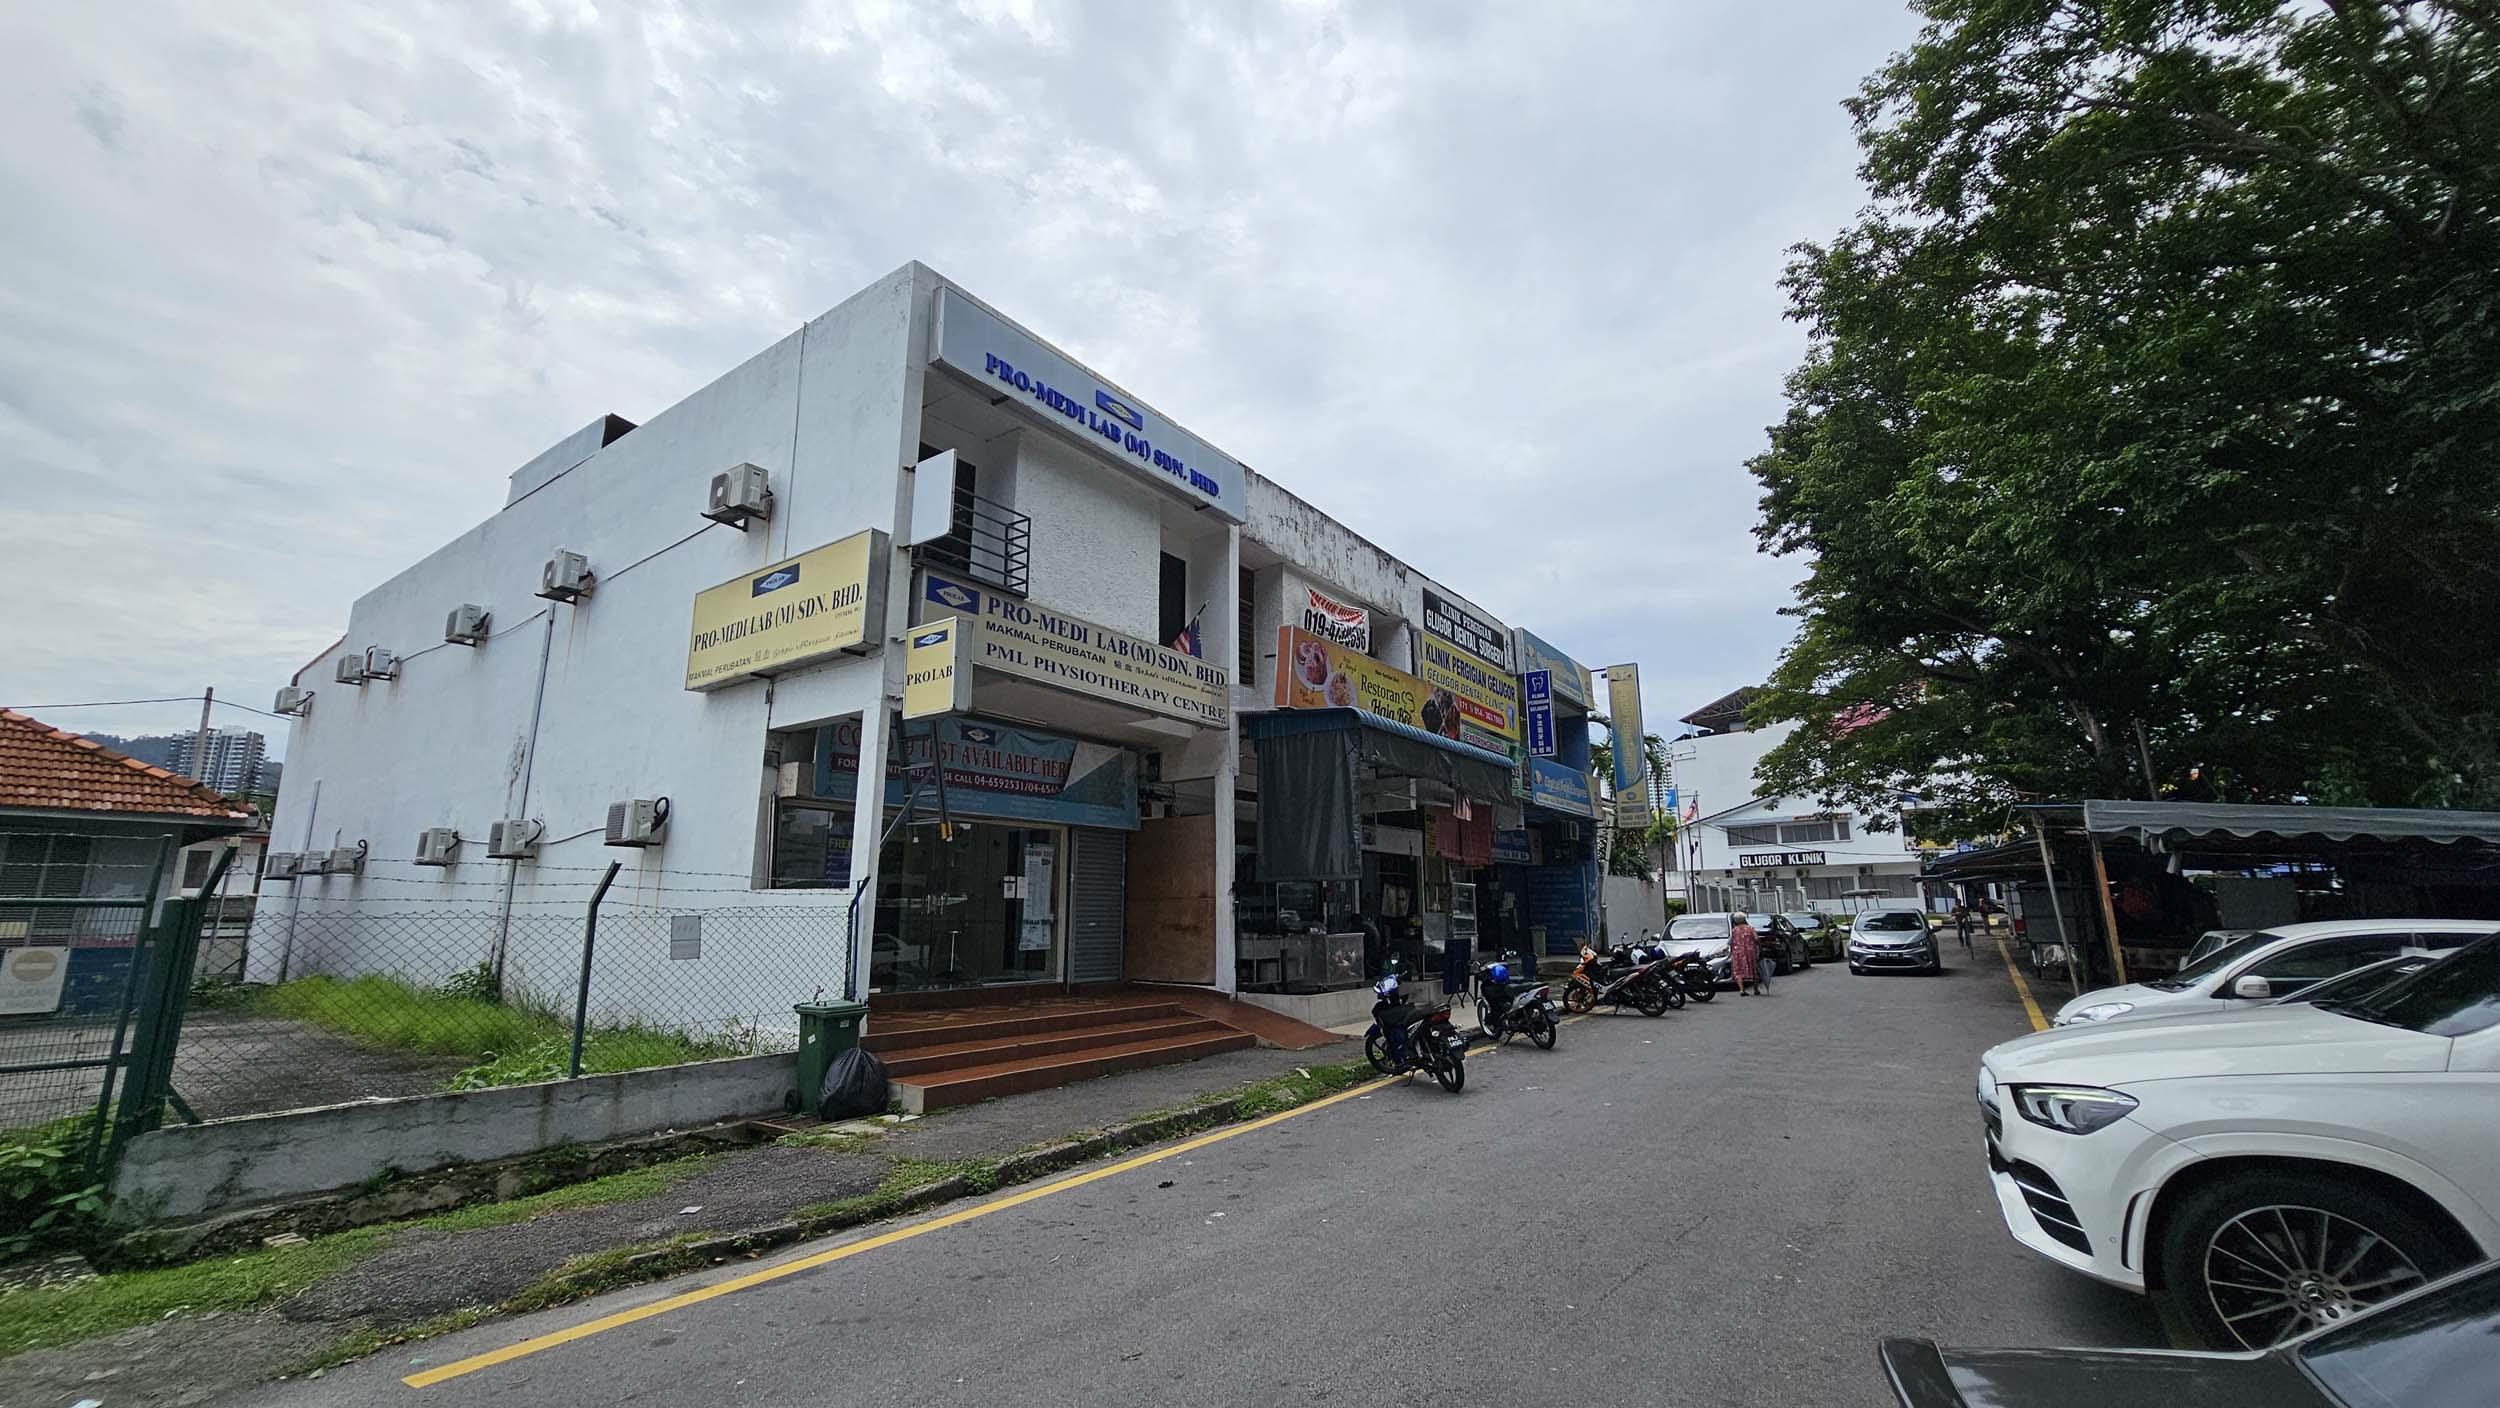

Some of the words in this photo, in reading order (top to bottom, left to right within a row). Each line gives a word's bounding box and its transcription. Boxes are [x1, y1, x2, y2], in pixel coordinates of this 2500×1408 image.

[985, 352, 1086, 425] PRO-MEDI
[1089, 411, 1121, 443] LAB
[1125, 432, 1151, 461] (M)
[1153, 449, 1187, 481] SDN.
[1190, 468, 1221, 499] BHD.
[694, 616, 748, 652] PRO-MEDI
[750, 611, 772, 635] LAB
[775, 601, 795, 628] (M)
[797, 594, 828, 620] SDN.
[831, 583, 863, 610] BHD.
[1426, 609, 1452, 636] GLUGOR
[1454, 623, 1477, 652] DENTAL
[1479, 637, 1504, 666] SURGERY
[1440, 600, 1461, 624] KLINIK
[1463, 612, 1492, 641] PERGIGIAN
[986, 621, 1039, 645] MAKMAL
[1042, 637, 1106, 664] PERUBATAN
[987, 596, 1088, 644] PRO-MEDI
[1097, 632, 1128, 656] LAB
[1131, 641, 1156, 667] (M)
[1158, 652, 1192, 677] SDN.
[1196, 664, 1228, 688] BHD.
[906, 665, 953, 686] PROLAB
[986, 642, 1028, 666] PML
[1034, 656, 1169, 704] PHYSIOTHERAPY
[1172, 695, 1226, 720] CENTRE
[1361, 674, 1400, 704] Restoran
[1425, 642, 1450, 671] KLINIK
[1451, 655, 1486, 687] PERGIGIAN
[1488, 673, 1516, 702] GELUGOR
[1427, 667, 1459, 691] GELUGOR
[1460, 680, 1483, 702] DENTAL
[1485, 692, 1504, 712] CLINIC
[838, 758, 857, 768] FOR
[955, 774, 972, 784] CALL
[962, 747, 1040, 775] AVAILABLE
[1741, 855, 1783, 867] GLUGOR
[1788, 853, 1824, 866] KLINIK
